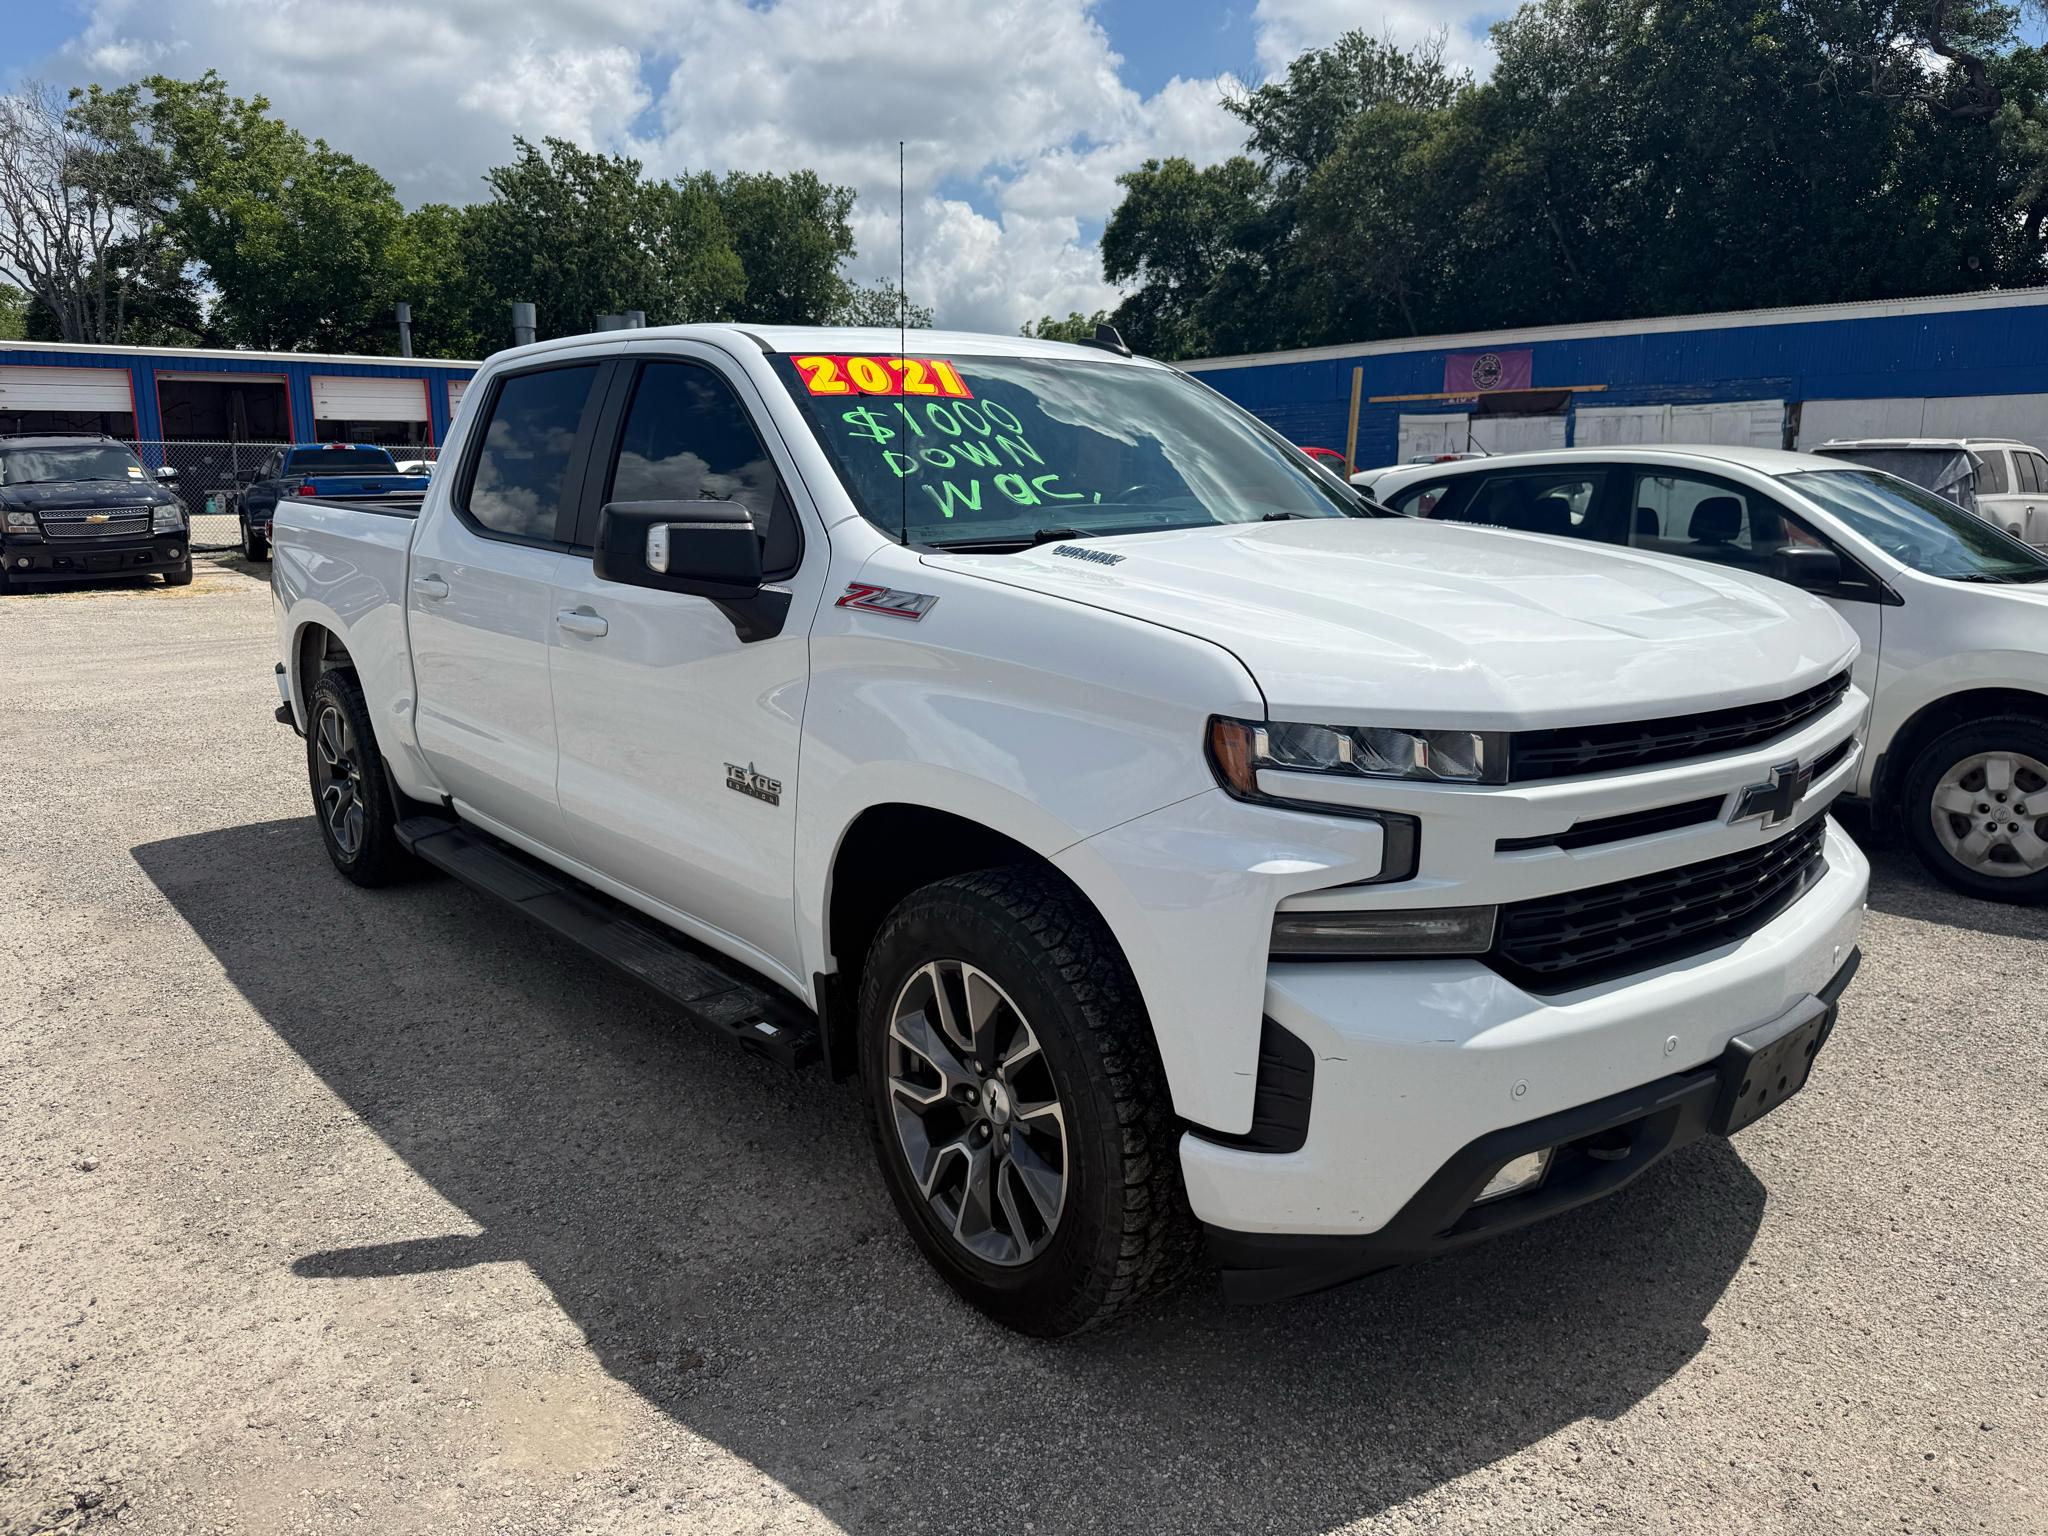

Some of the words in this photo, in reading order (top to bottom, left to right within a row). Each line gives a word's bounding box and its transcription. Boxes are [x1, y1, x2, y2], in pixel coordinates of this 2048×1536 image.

[797, 357, 966, 396] 2021
[842, 399, 1023, 444] $1000
[882, 435, 1045, 478] DOWN
